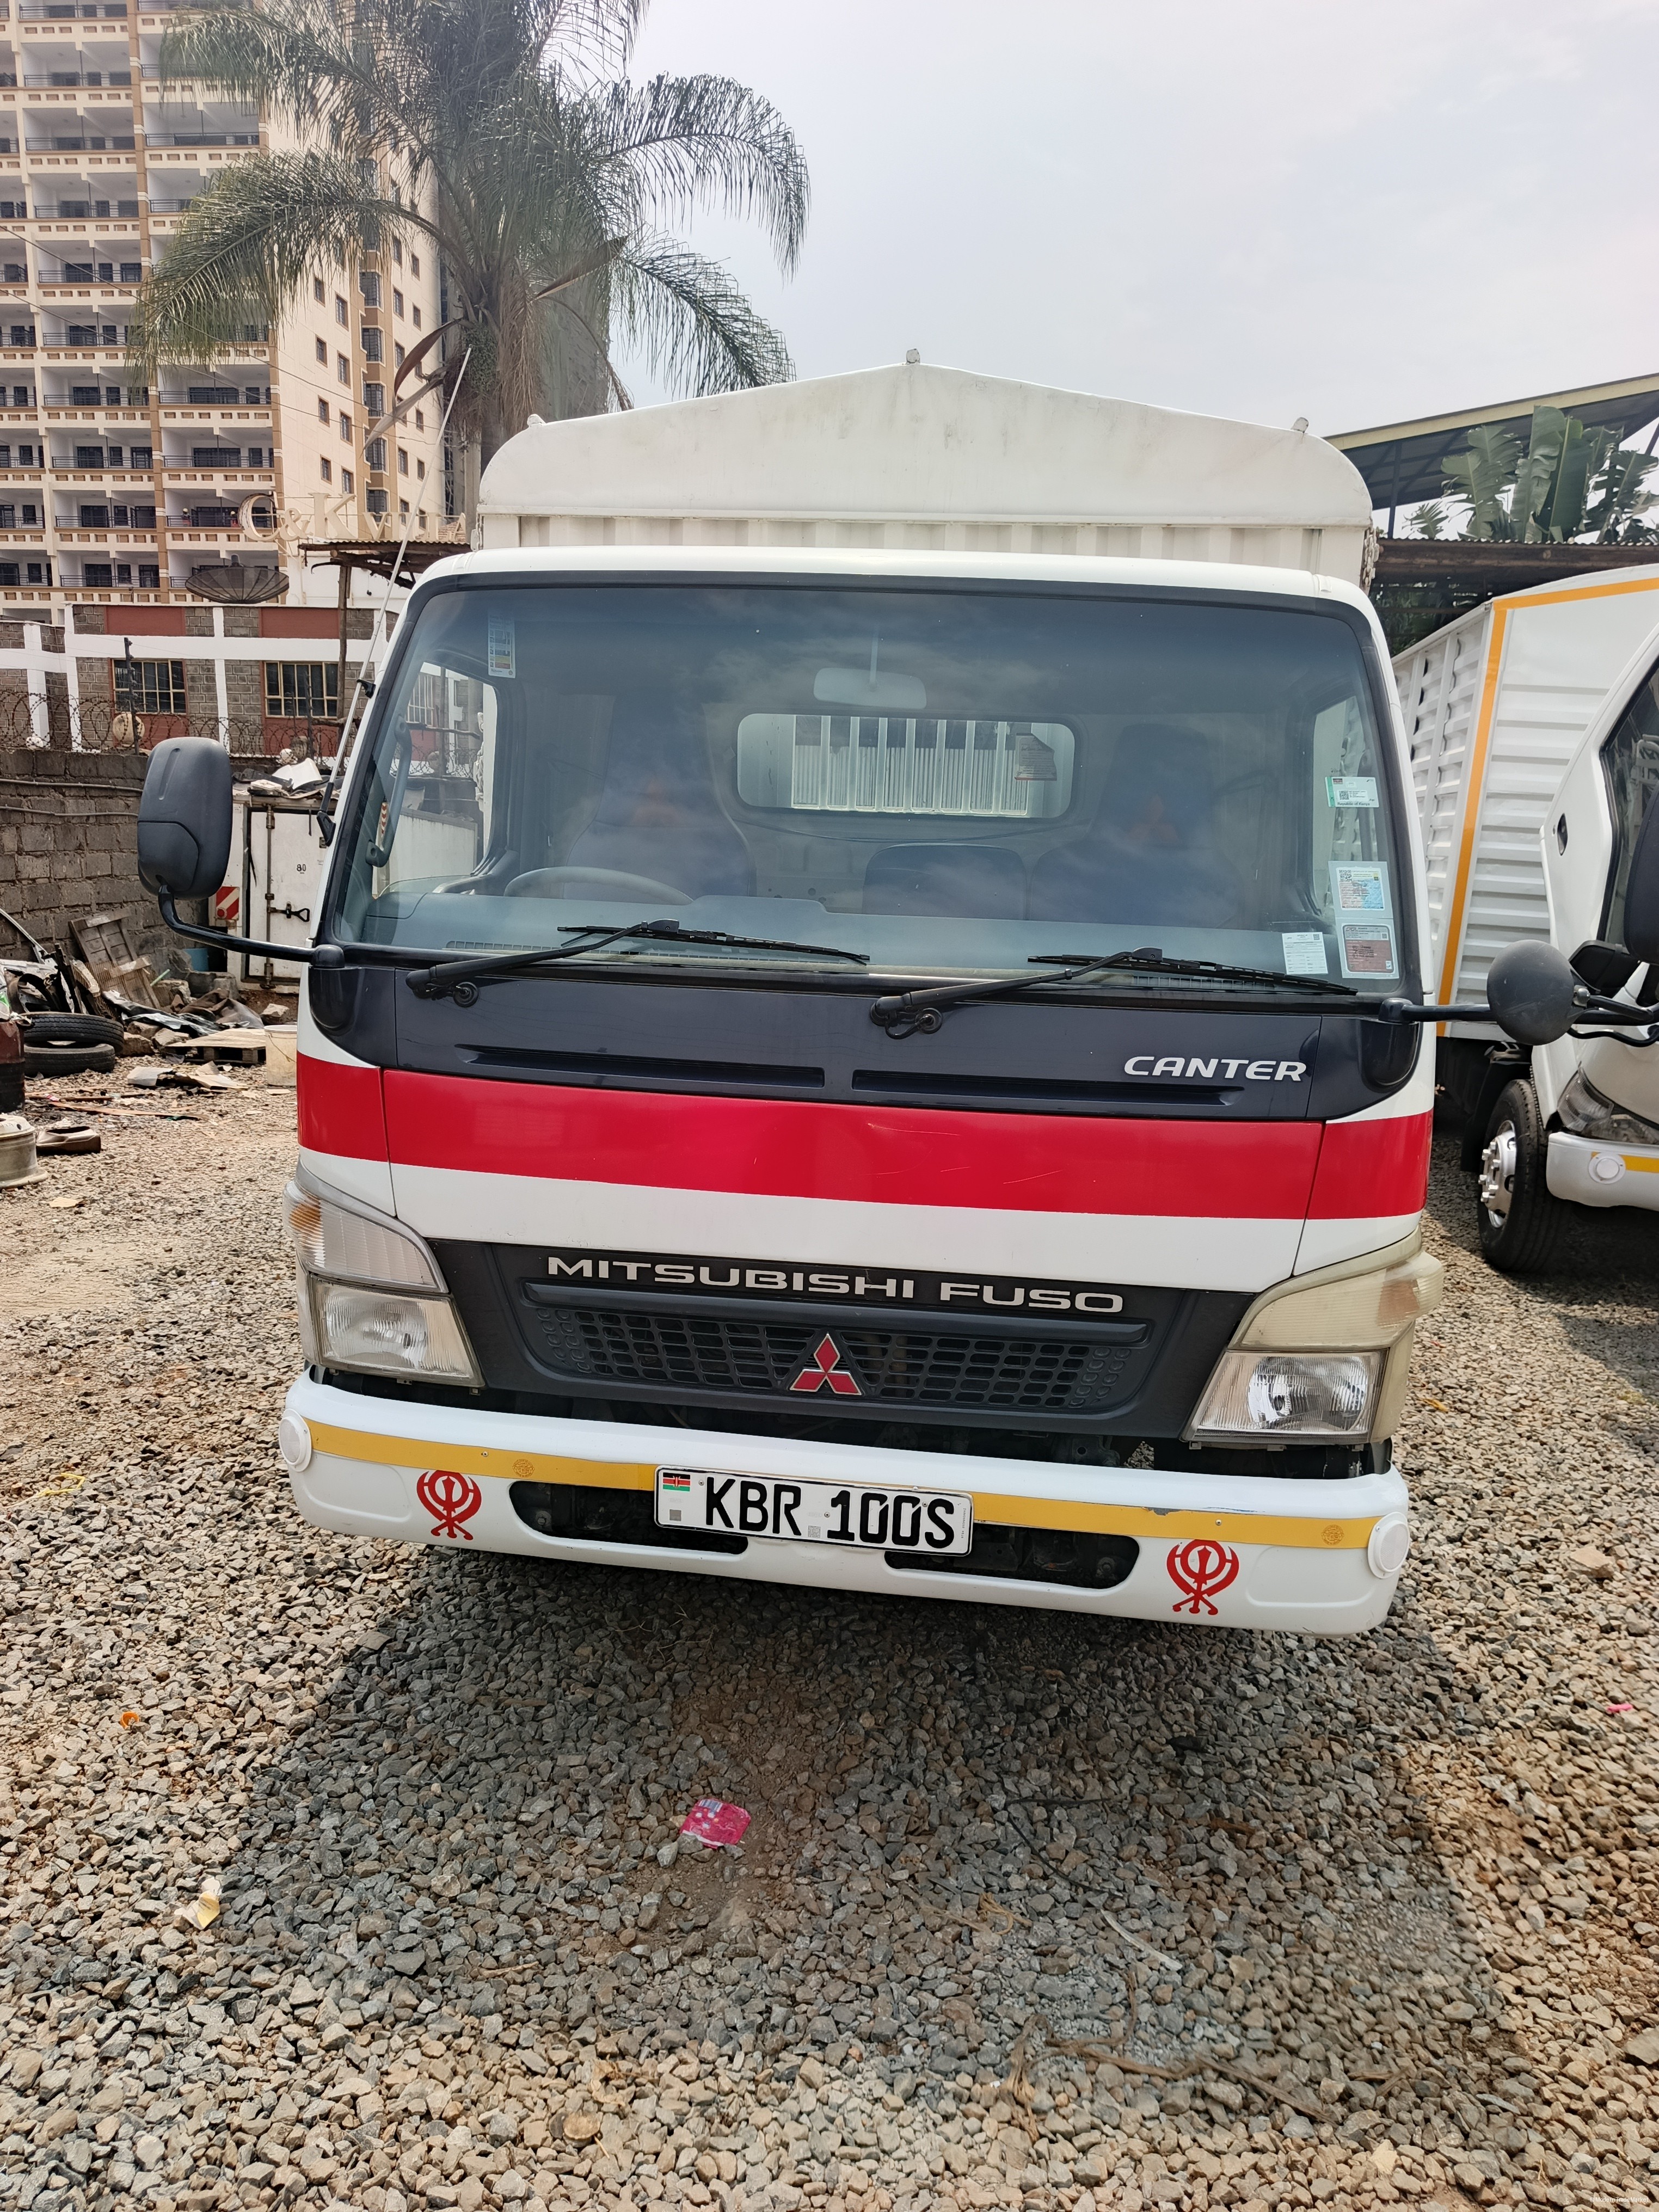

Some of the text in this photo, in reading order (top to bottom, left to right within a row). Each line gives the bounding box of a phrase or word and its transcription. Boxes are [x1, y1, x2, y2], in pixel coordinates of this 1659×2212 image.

[296, 864, 306, 872] 80
[1124, 1056, 1307, 1082] CANTER
[548, 1256, 1123, 1313] MITSUBISHI FUSO
[705, 1477, 802, 1536] KBR
[827, 1490, 955, 1549] 100S
